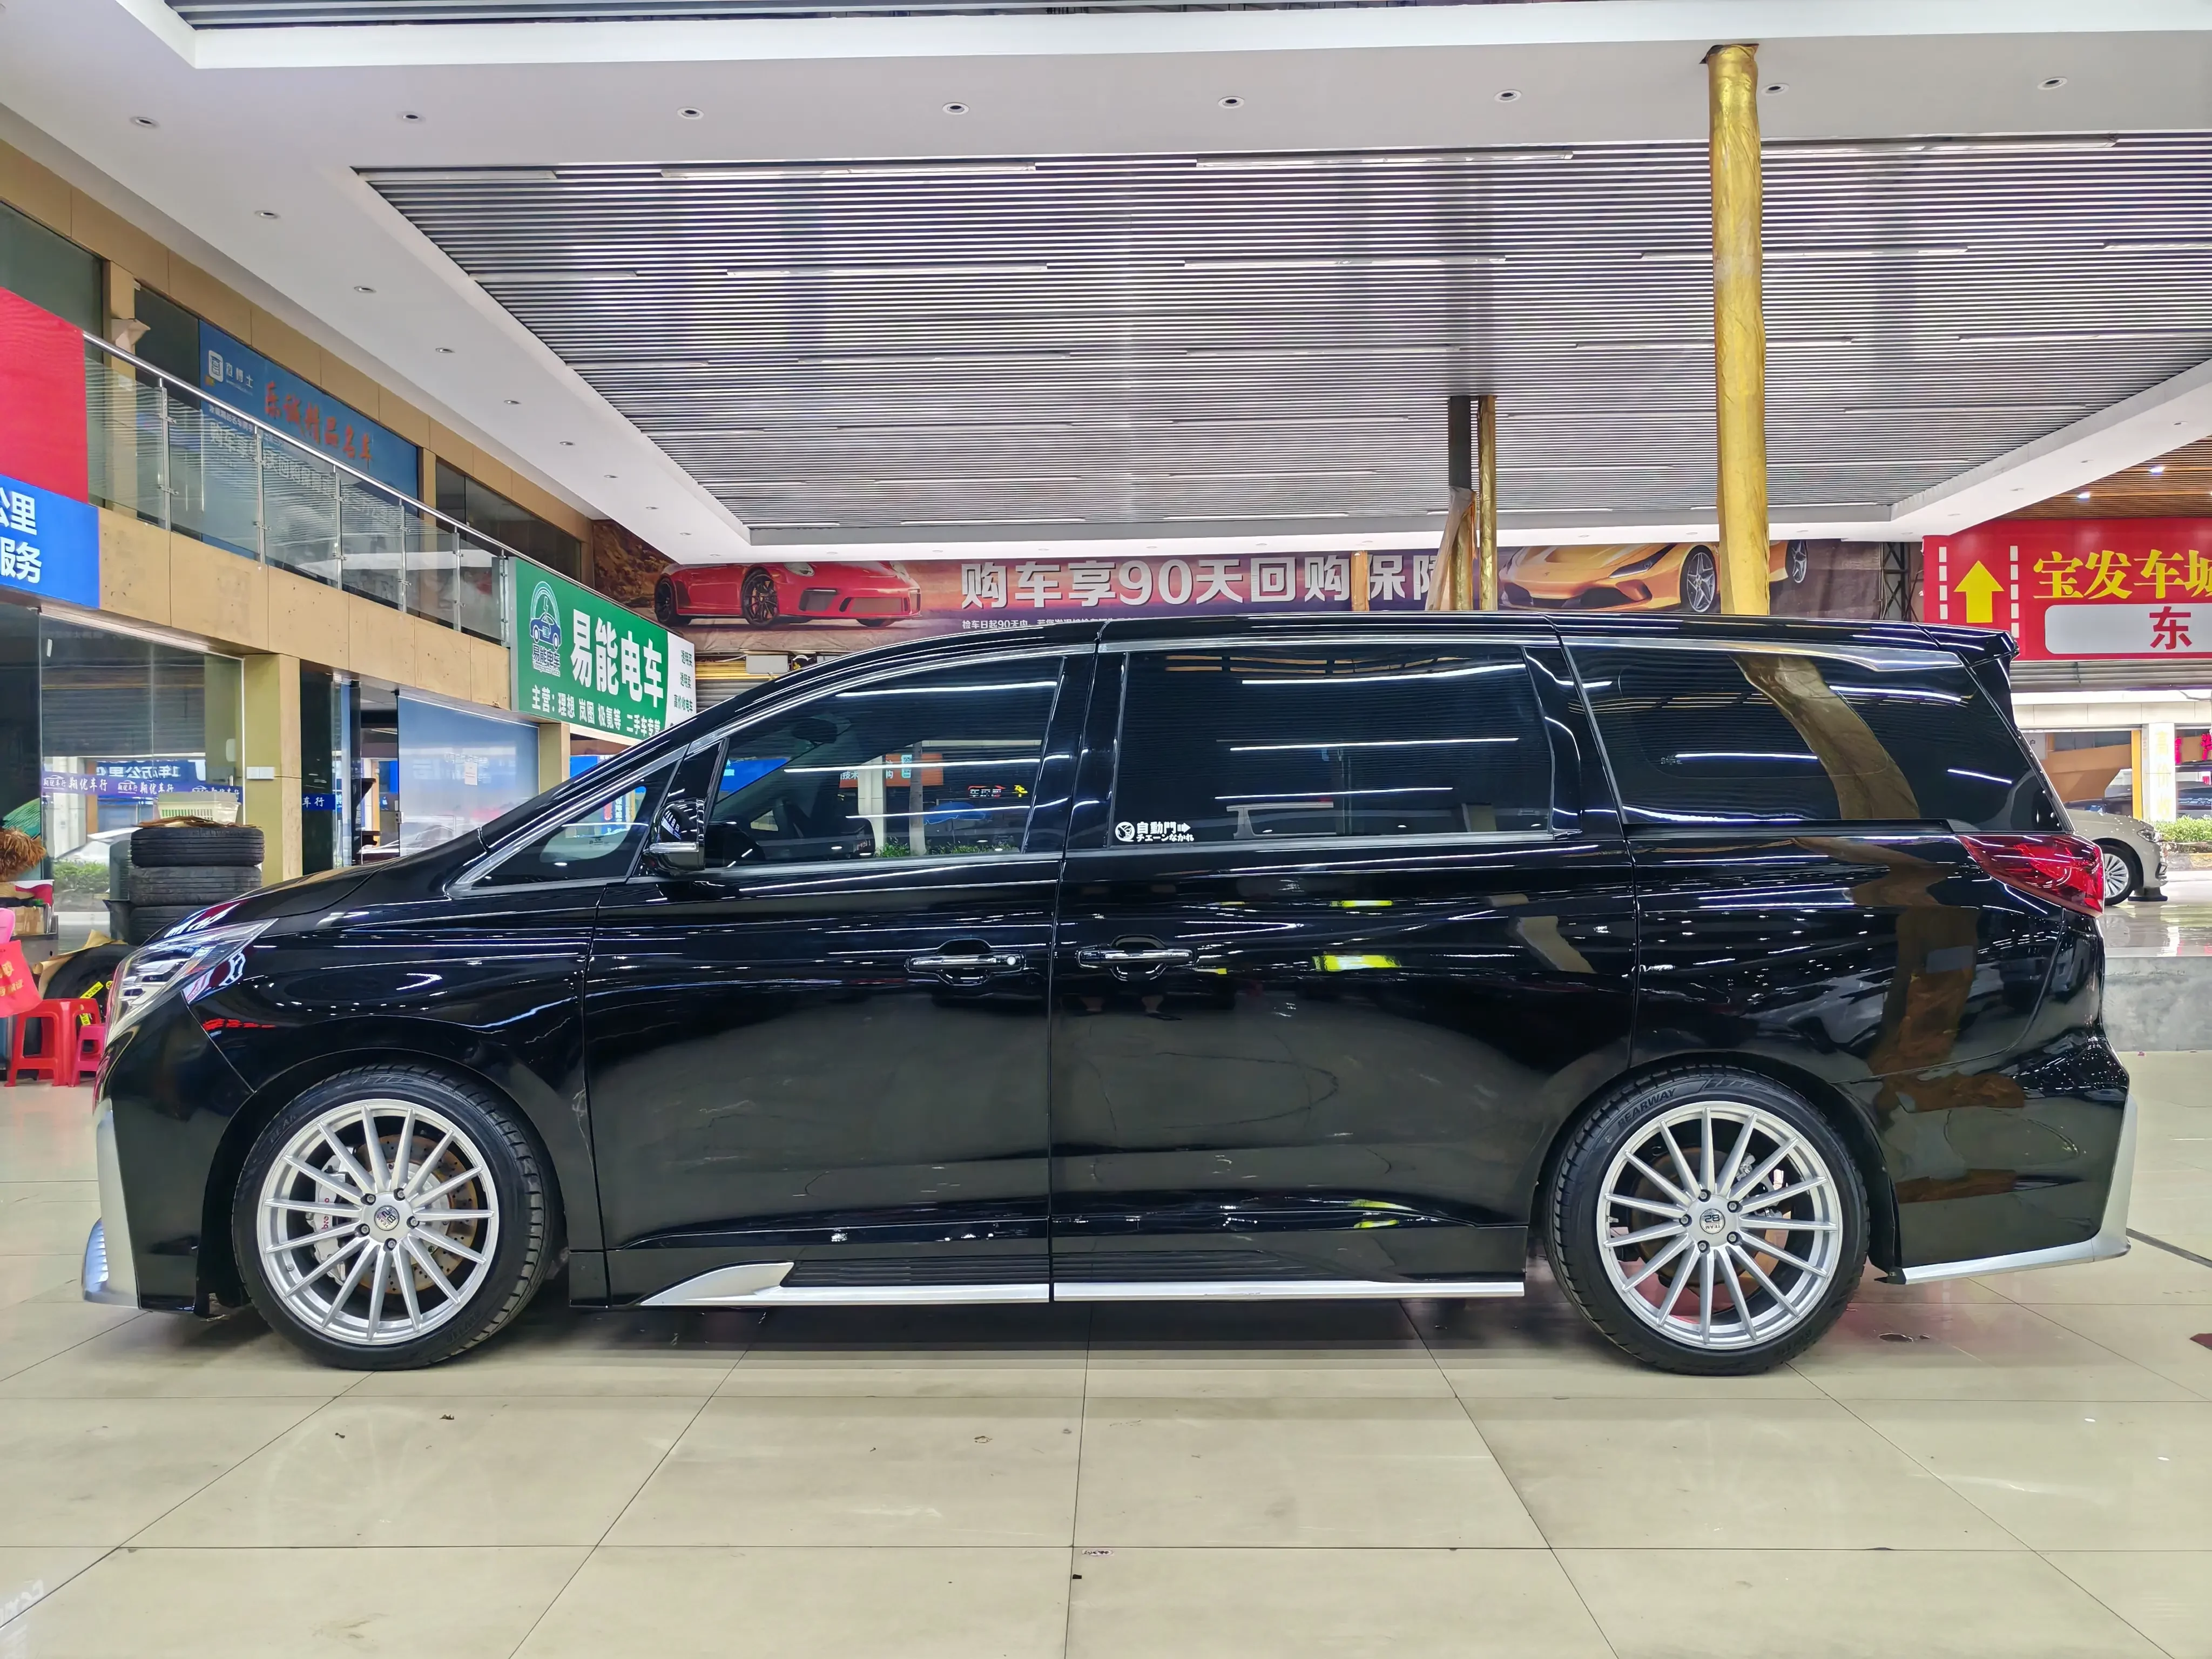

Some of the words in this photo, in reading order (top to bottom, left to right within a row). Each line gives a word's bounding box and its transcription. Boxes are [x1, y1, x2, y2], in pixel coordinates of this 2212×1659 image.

[2149, 606, 2193, 650] 东
[532, 643, 561, 667] 易能电车
[570, 608, 664, 709] 易能电车
[578, 698, 595, 725] 岚图
[598, 703, 622, 731] 极氪等
[626, 713, 661, 737] 二手车专营
[840, 771, 859, 780] 技术
[302, 796, 325, 809] 车行
[1136, 821, 1177, 834] 自動門
